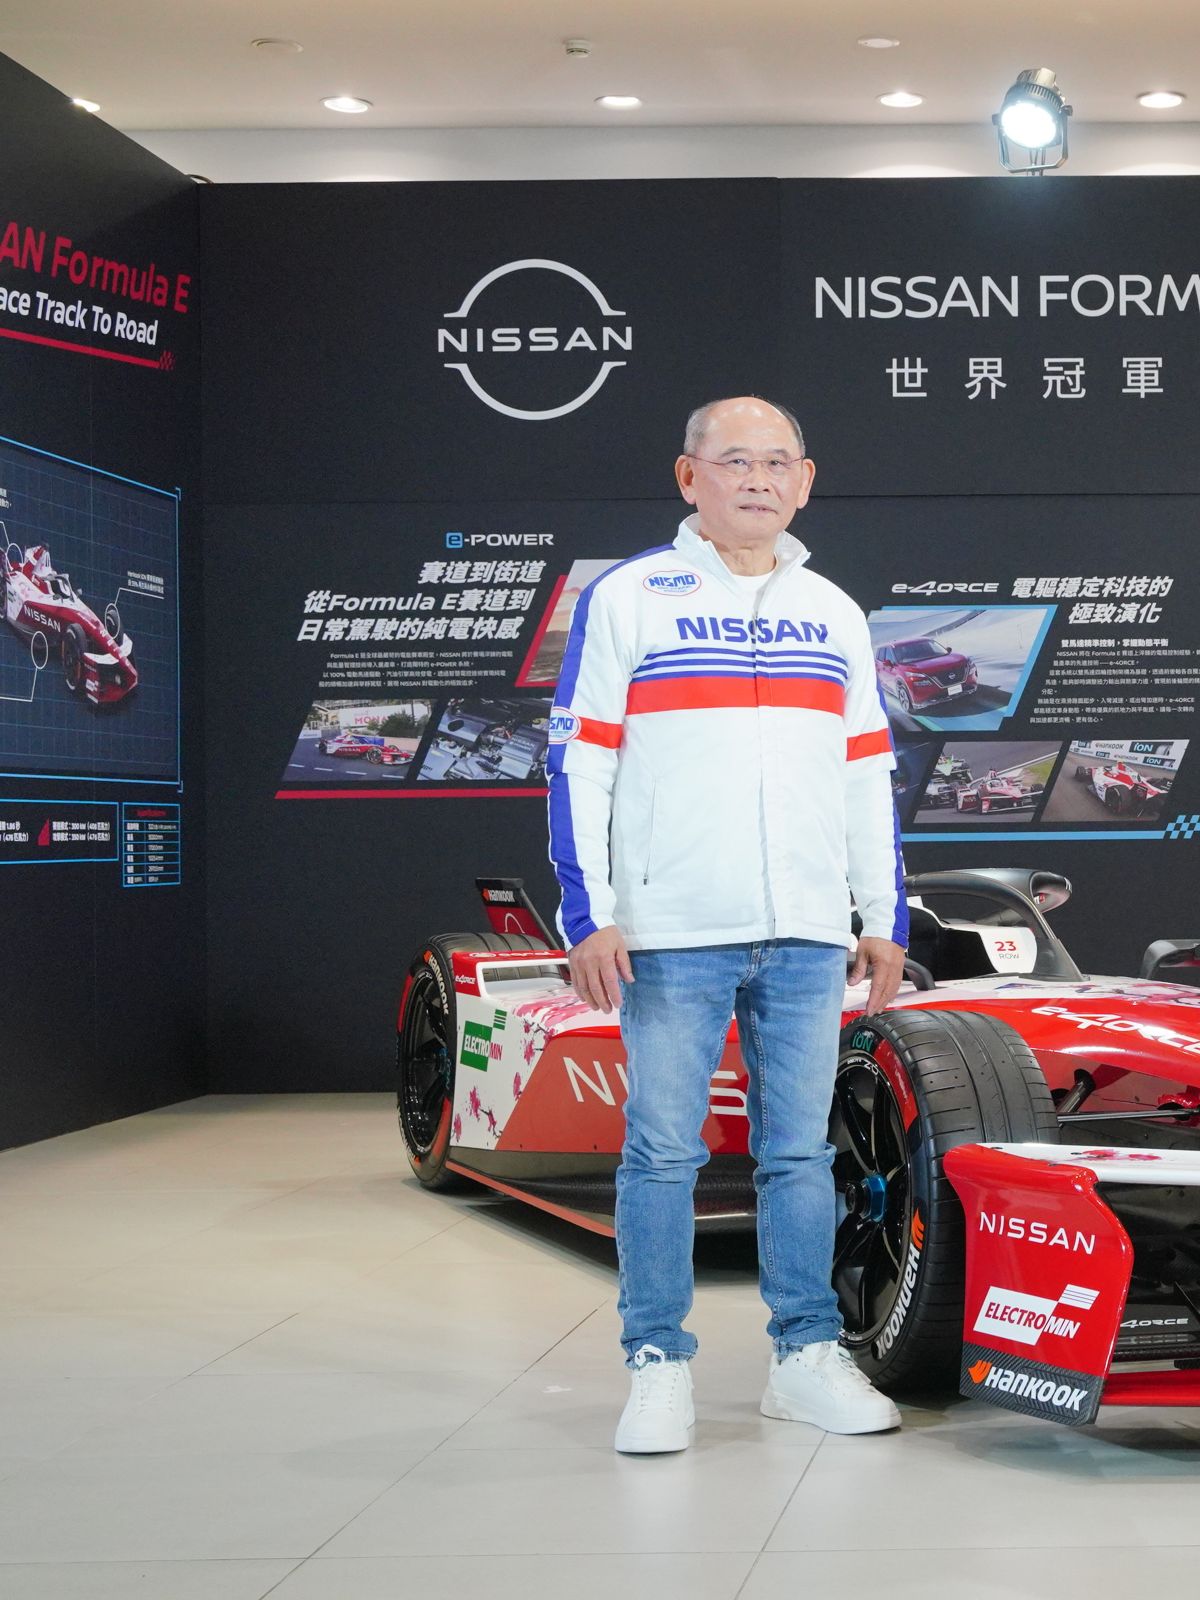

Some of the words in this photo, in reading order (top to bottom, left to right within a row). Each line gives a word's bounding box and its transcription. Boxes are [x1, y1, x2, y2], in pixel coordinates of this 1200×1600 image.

[0, 220, 46, 274] AN
[51, 236, 168, 307] Formula
[174, 273, 192, 313] E
[814, 275, 1020, 319] NISSAN
[36, 291, 86, 330] Track
[92, 305, 111, 335] To
[115, 311, 159, 346] Road
[438, 326, 632, 353] NISSAN
[418, 560, 547, 584] 賽道到街道
[648, 575, 696, 587] NISMO
[1010, 576, 1173, 599] 電驅穩定科技的
[24, 604, 61, 632] NISSAN
[1068, 602, 1162, 625] 極致演化
[297, 616, 525, 641] 日常駕駛的純電快感
[675, 616, 829, 644] NISSAN
[994, 941, 1017, 952] 23
[979, 1211, 1096, 1255] NISSAN
[984, 1301, 1081, 1339] ELECTROMIN
